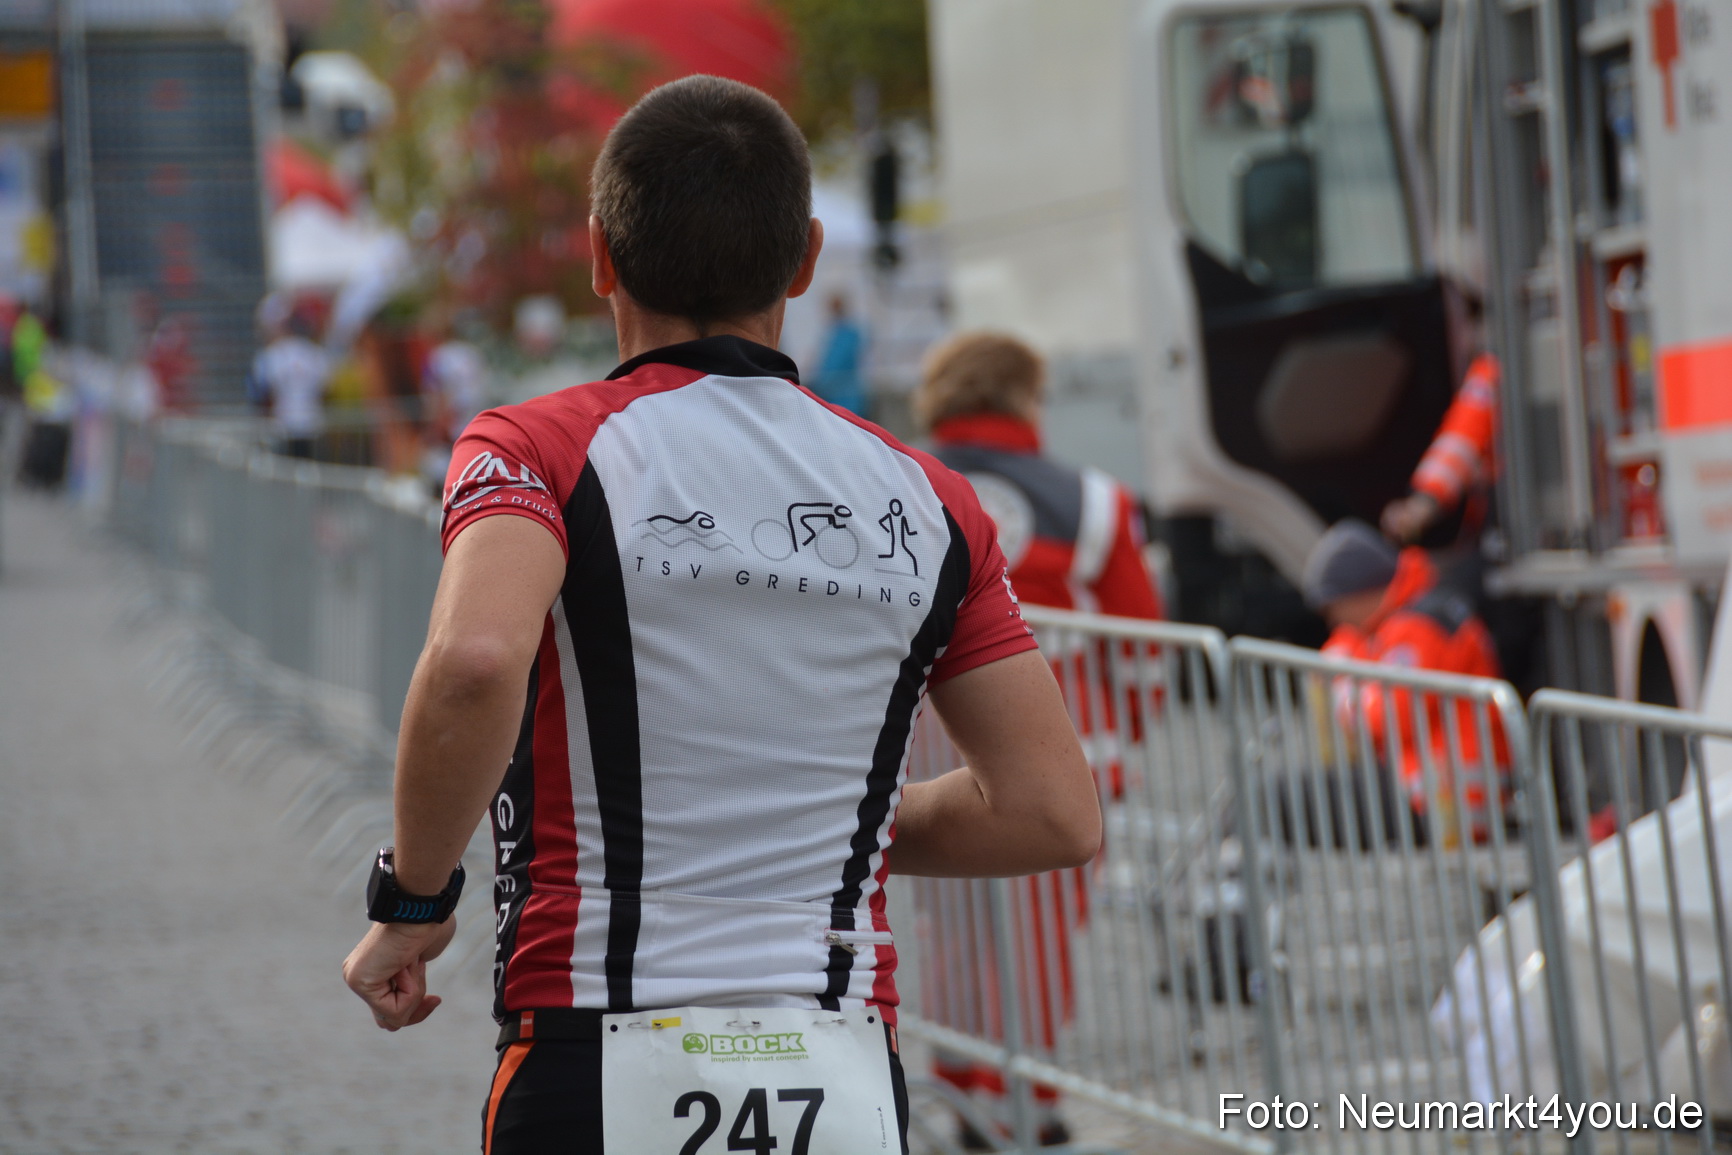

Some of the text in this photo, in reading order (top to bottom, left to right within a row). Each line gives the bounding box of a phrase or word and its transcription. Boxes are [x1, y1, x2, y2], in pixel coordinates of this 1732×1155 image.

[511, 495, 557, 521] Druck
[636, 557, 921, 607] TSV GREDING
[709, 1033, 807, 1055] BOCK
[710, 1055, 741, 1064] inspired
[753, 1054, 774, 1062] smart
[775, 1053, 809, 1062] concepts
[673, 1088, 825, 1155] 247
